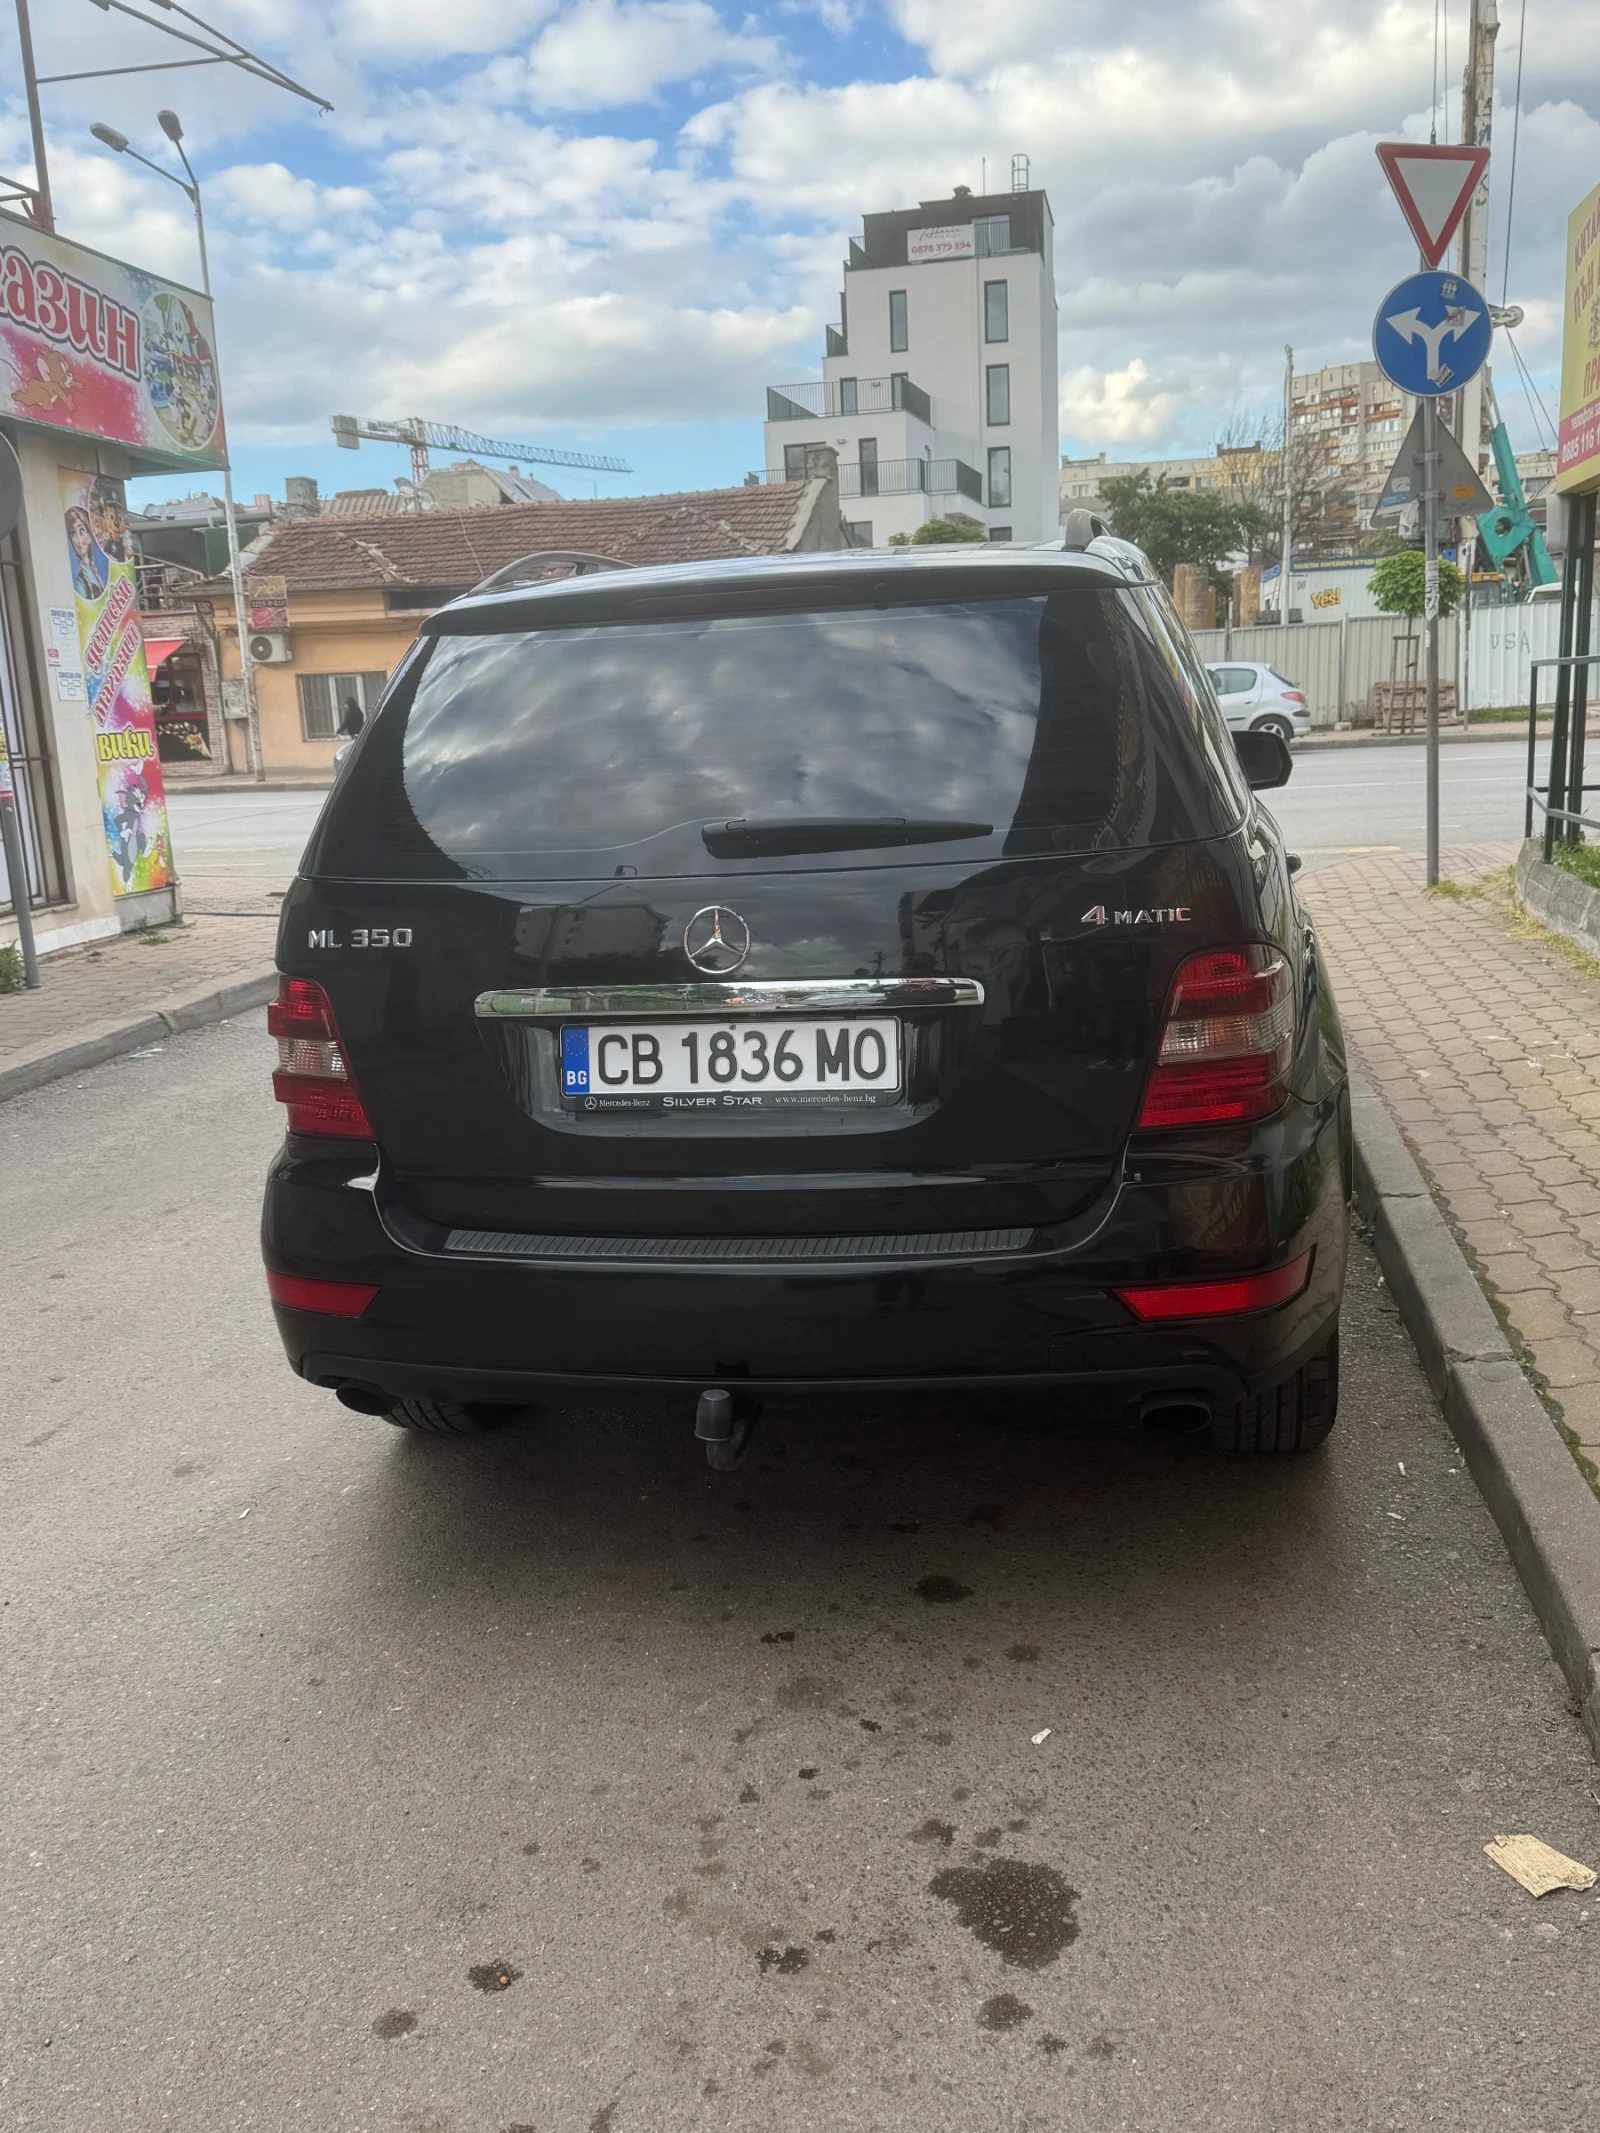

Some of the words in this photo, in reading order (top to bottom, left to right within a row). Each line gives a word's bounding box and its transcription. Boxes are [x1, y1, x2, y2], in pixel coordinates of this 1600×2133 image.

[911, 244, 934, 254] 0878
[936, 242, 953, 252] 379
[954, 240, 972, 250] 594
[0, 247, 140, 380] азин
[1570, 405, 1594, 430] телефон
[1562, 435, 1579, 464] 0885
[1581, 427, 1595, 453] 116
[1310, 587, 1341, 610] Yes!
[85, 576, 134, 674] детски
[1491, 631, 1531, 653] USA
[92, 621, 141, 726] магазин
[308, 929, 342, 948] ML
[351, 928, 413, 948] 350
[598, 1034, 663, 1085] CB
[681, 1028, 803, 1084] 1836
[816, 1028, 886, 1082] MO
[566, 1070, 587, 1085] BG
[600, 1098, 650, 1107] Mercedes-Benz
[663, 1096, 716, 1107] SILVER
[722, 1095, 762, 1106] STAR
[775, 1093, 876, 1104] www.mercedes-benz.bg
